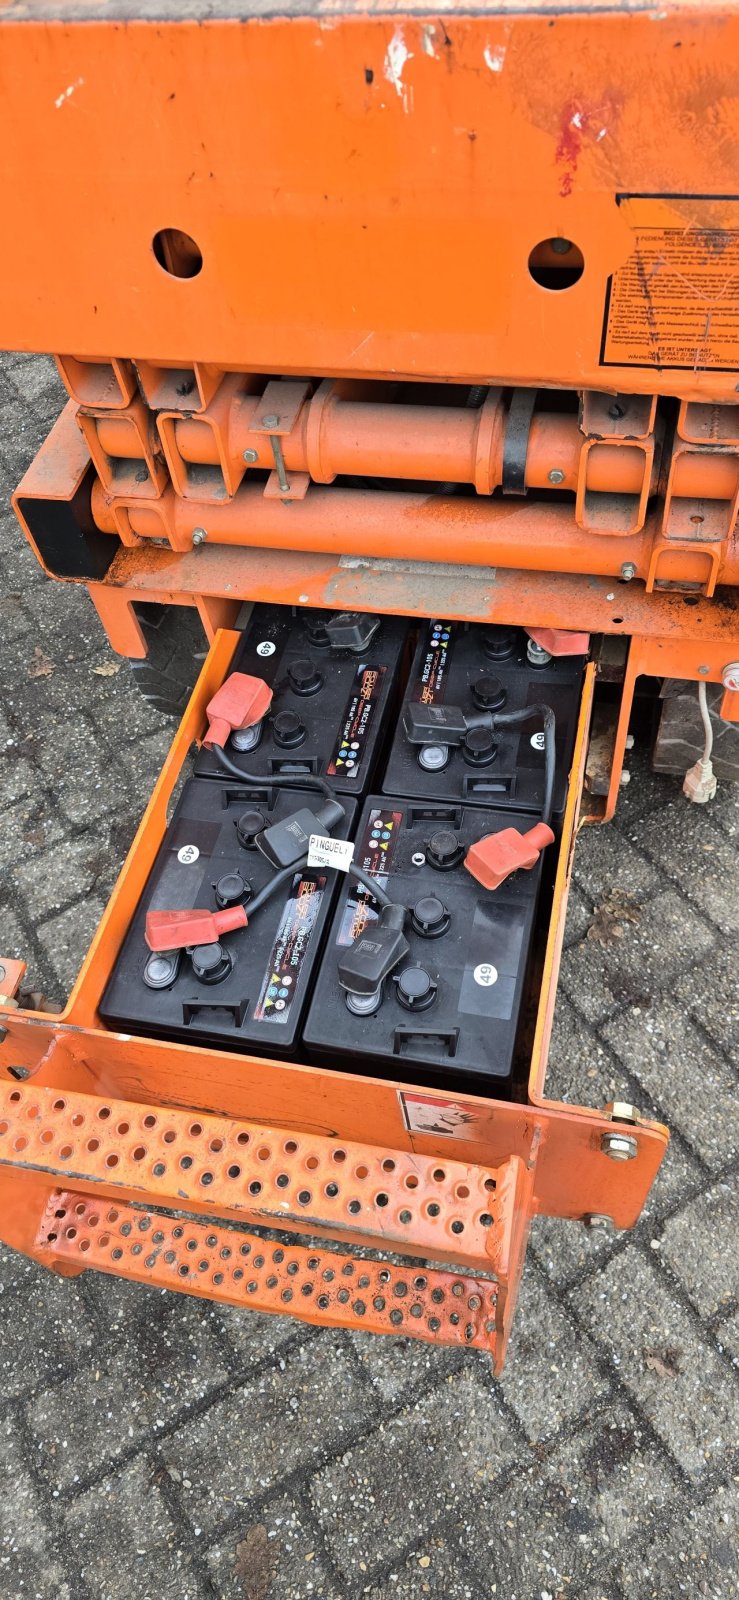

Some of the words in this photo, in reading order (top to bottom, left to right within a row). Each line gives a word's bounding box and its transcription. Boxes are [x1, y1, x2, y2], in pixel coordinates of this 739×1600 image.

[260, 643, 272, 655] 49
[180, 846, 195, 862] 49
[479, 966, 492, 984] 49
